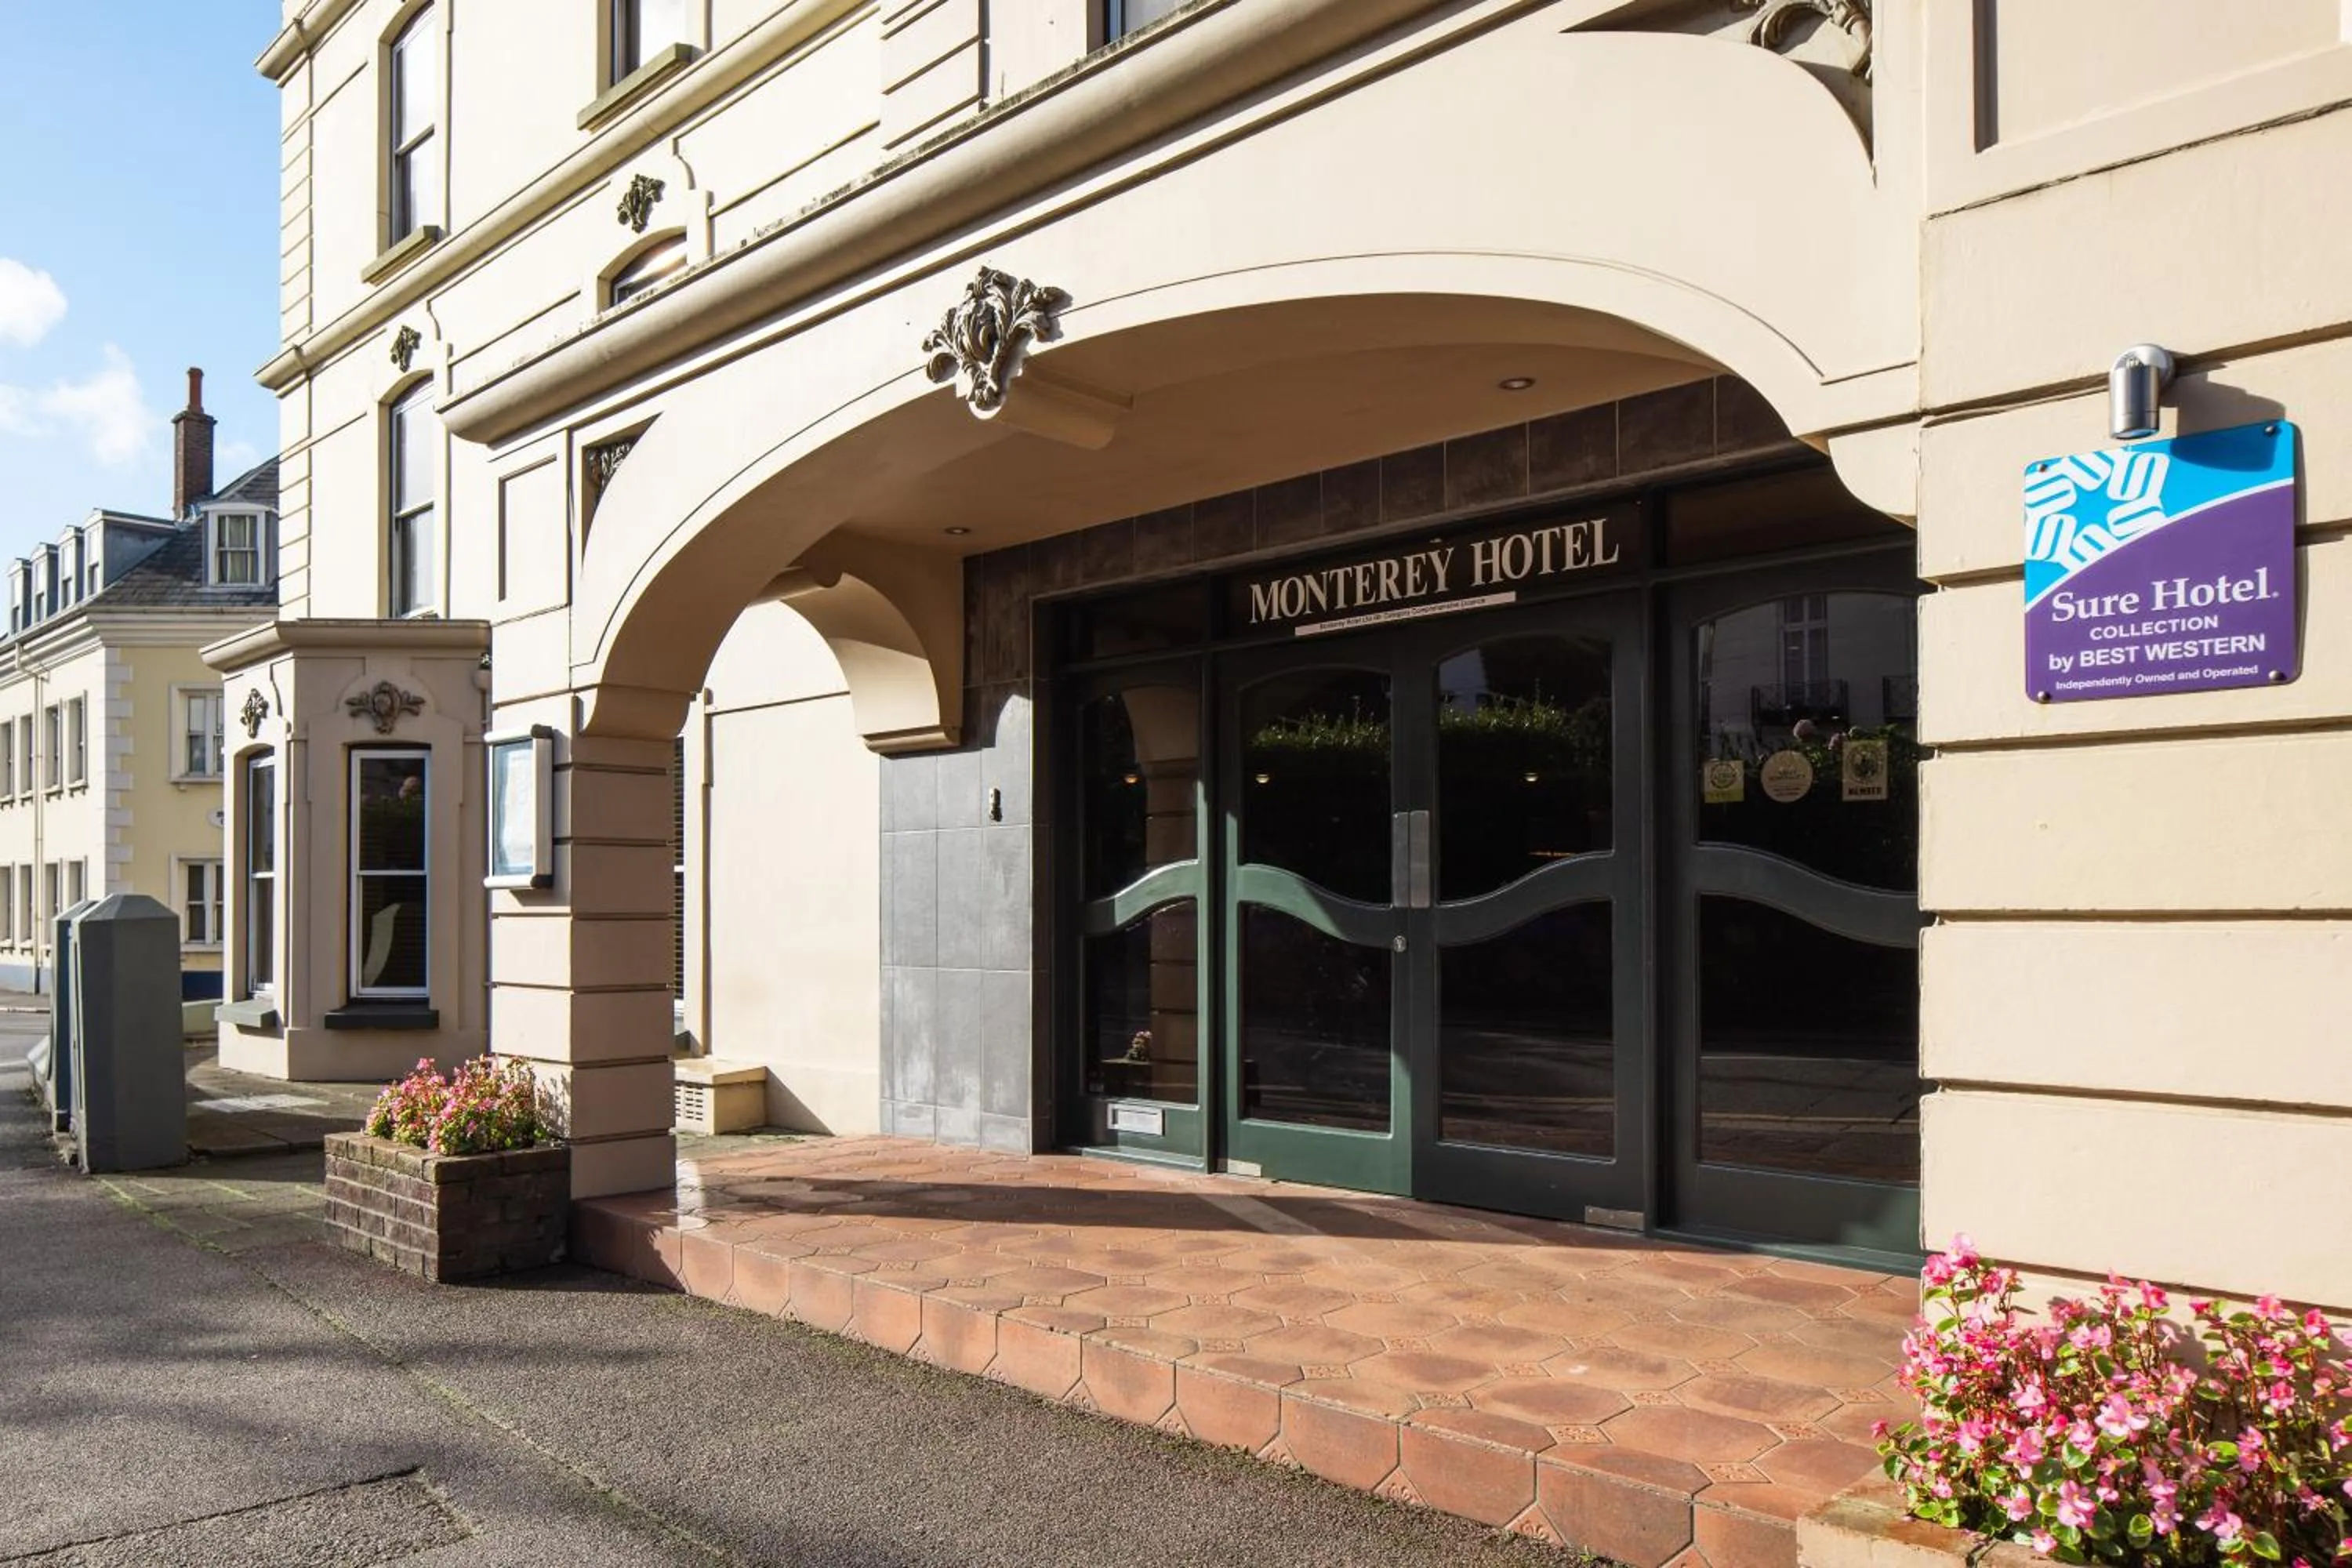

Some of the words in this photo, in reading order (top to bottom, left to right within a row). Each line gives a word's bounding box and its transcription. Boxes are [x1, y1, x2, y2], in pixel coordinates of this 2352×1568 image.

[1250, 547, 1454, 623] MONTEREY
[1471, 518, 1619, 586] HOTEL
[2052, 590, 2140, 622] Sure
[2090, 615, 2218, 641] COLLECTION
[2049, 654, 2074, 673] by
[2080, 646, 2140, 667] BEST
[2144, 633, 2265, 661] WESTERN
[2056, 675, 2132, 690] Independently
[2135, 673, 2175, 684] Owned
[2178, 669, 2201, 680] and
[2203, 665, 2259, 680] Operated
